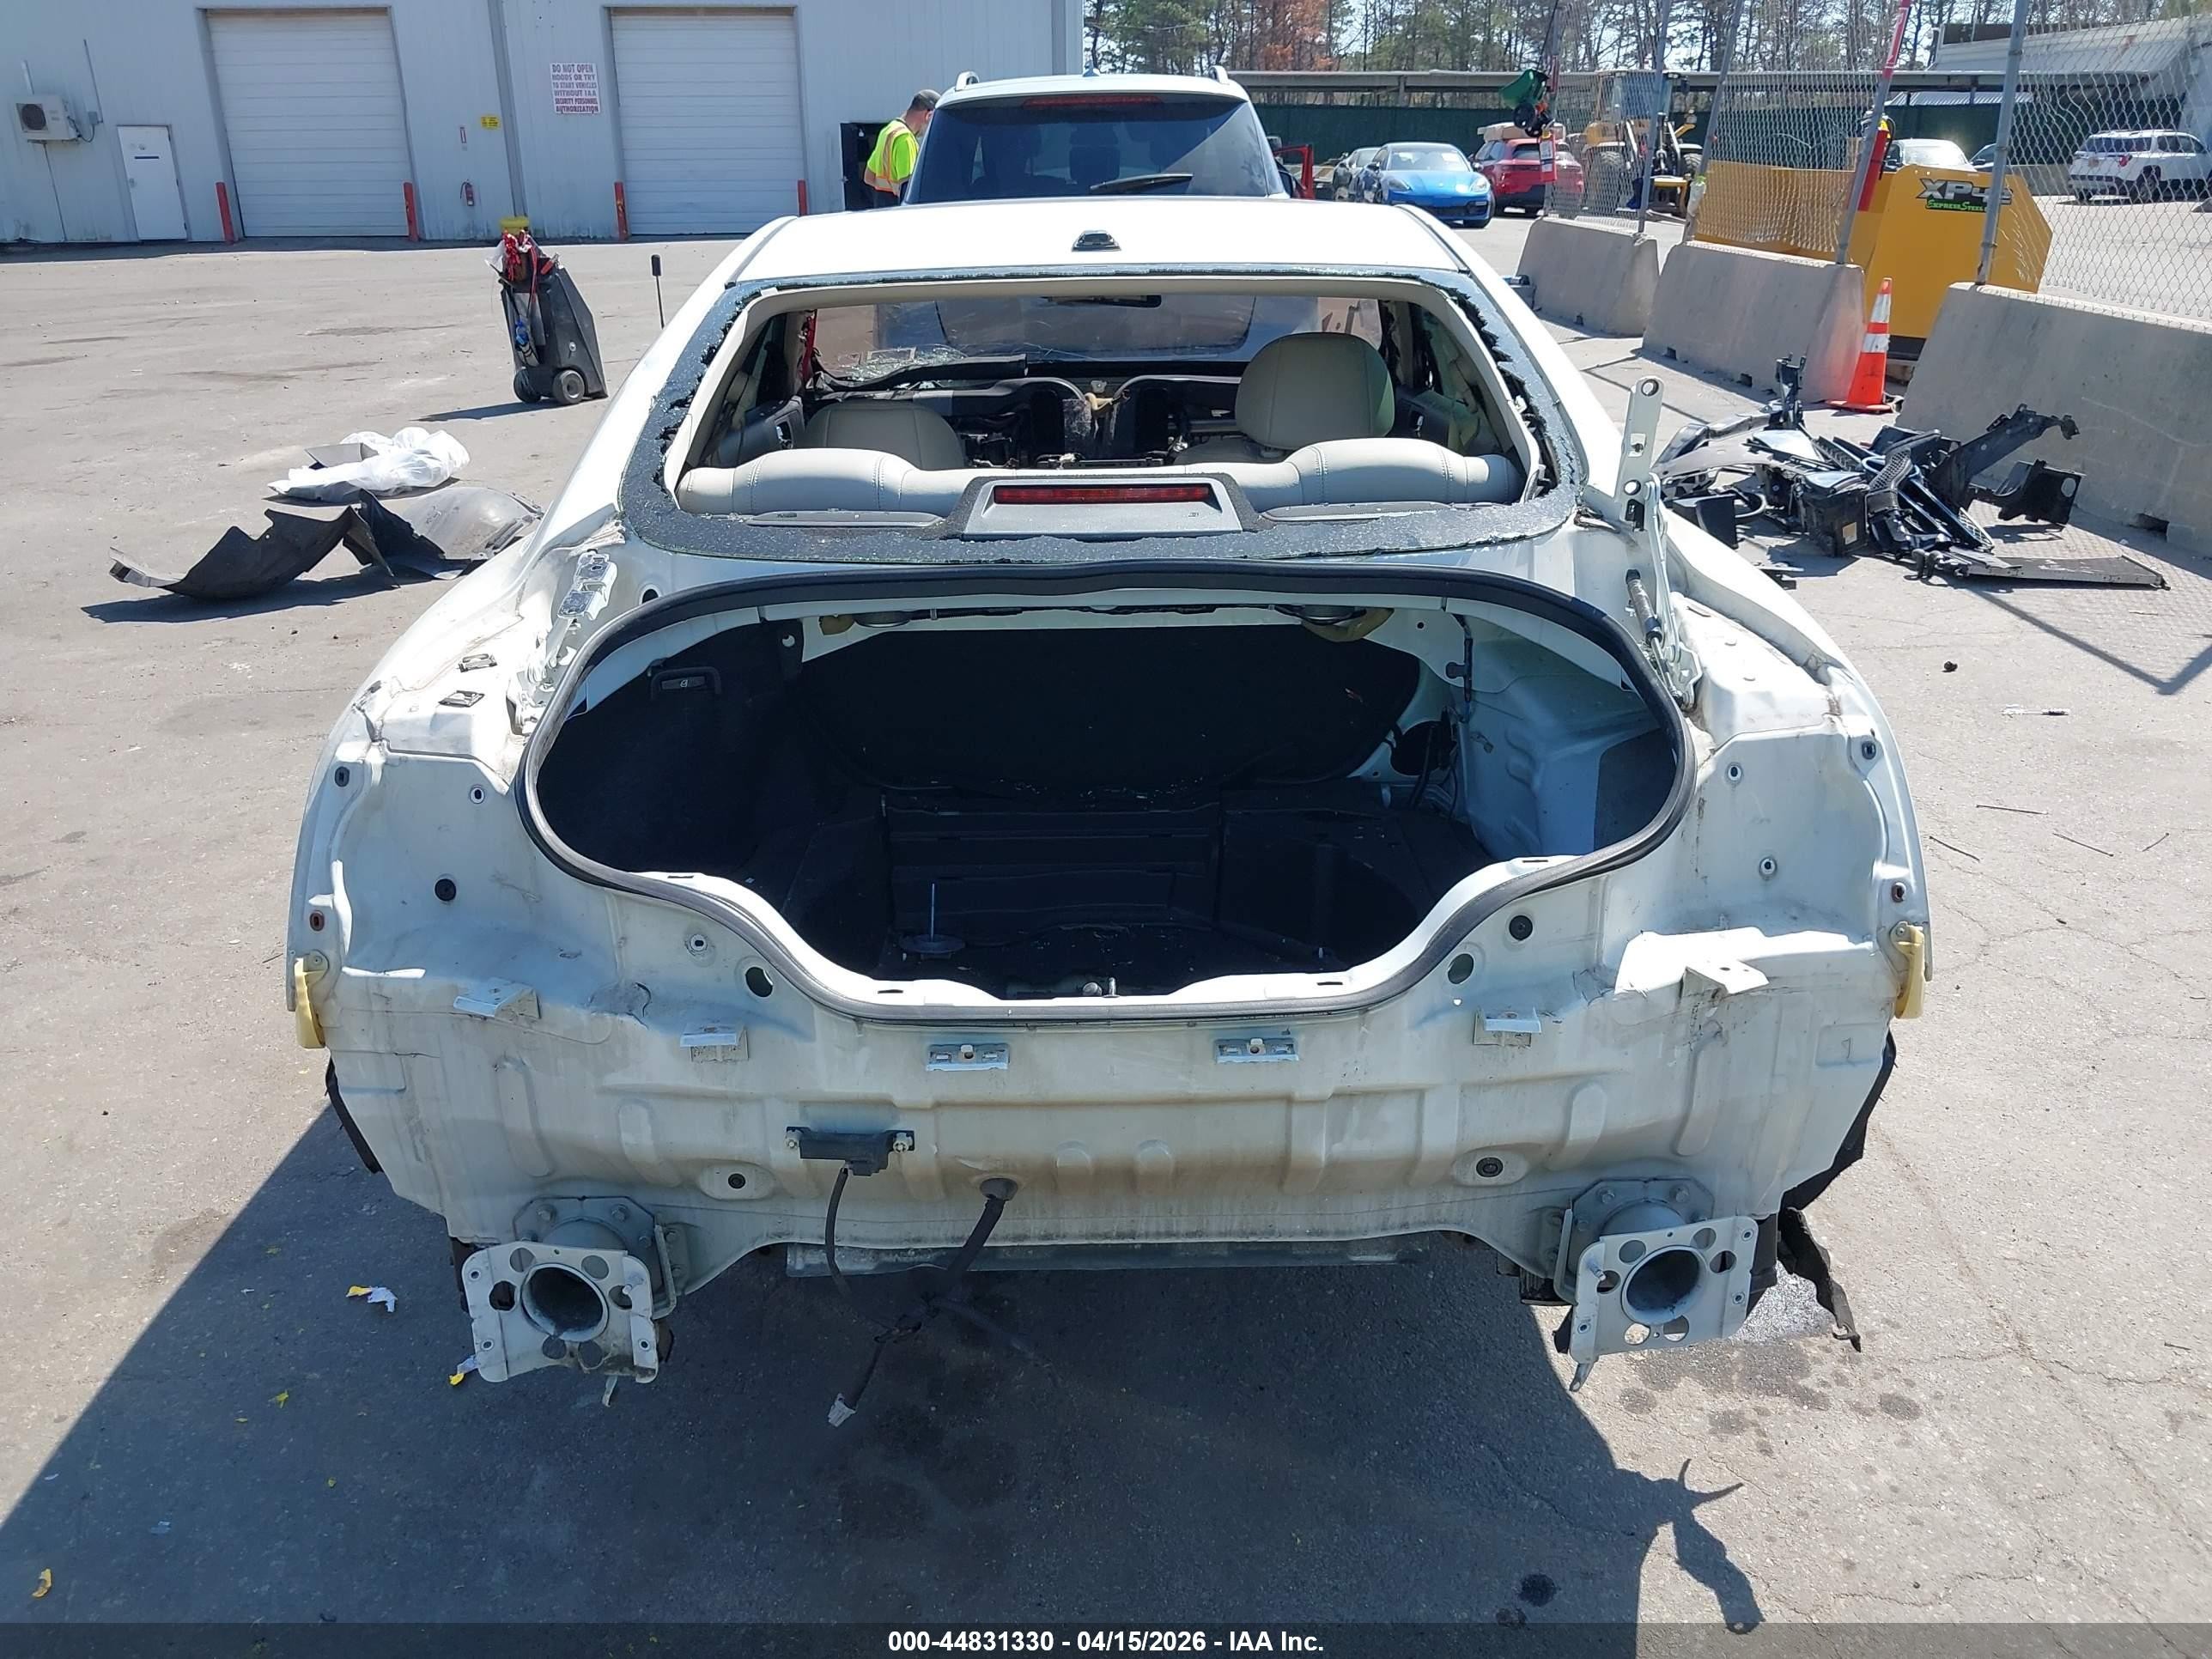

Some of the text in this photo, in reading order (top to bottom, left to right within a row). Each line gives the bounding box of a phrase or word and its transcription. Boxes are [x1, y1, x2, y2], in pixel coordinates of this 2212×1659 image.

[552, 64, 593, 74] DO NOT OPEN
